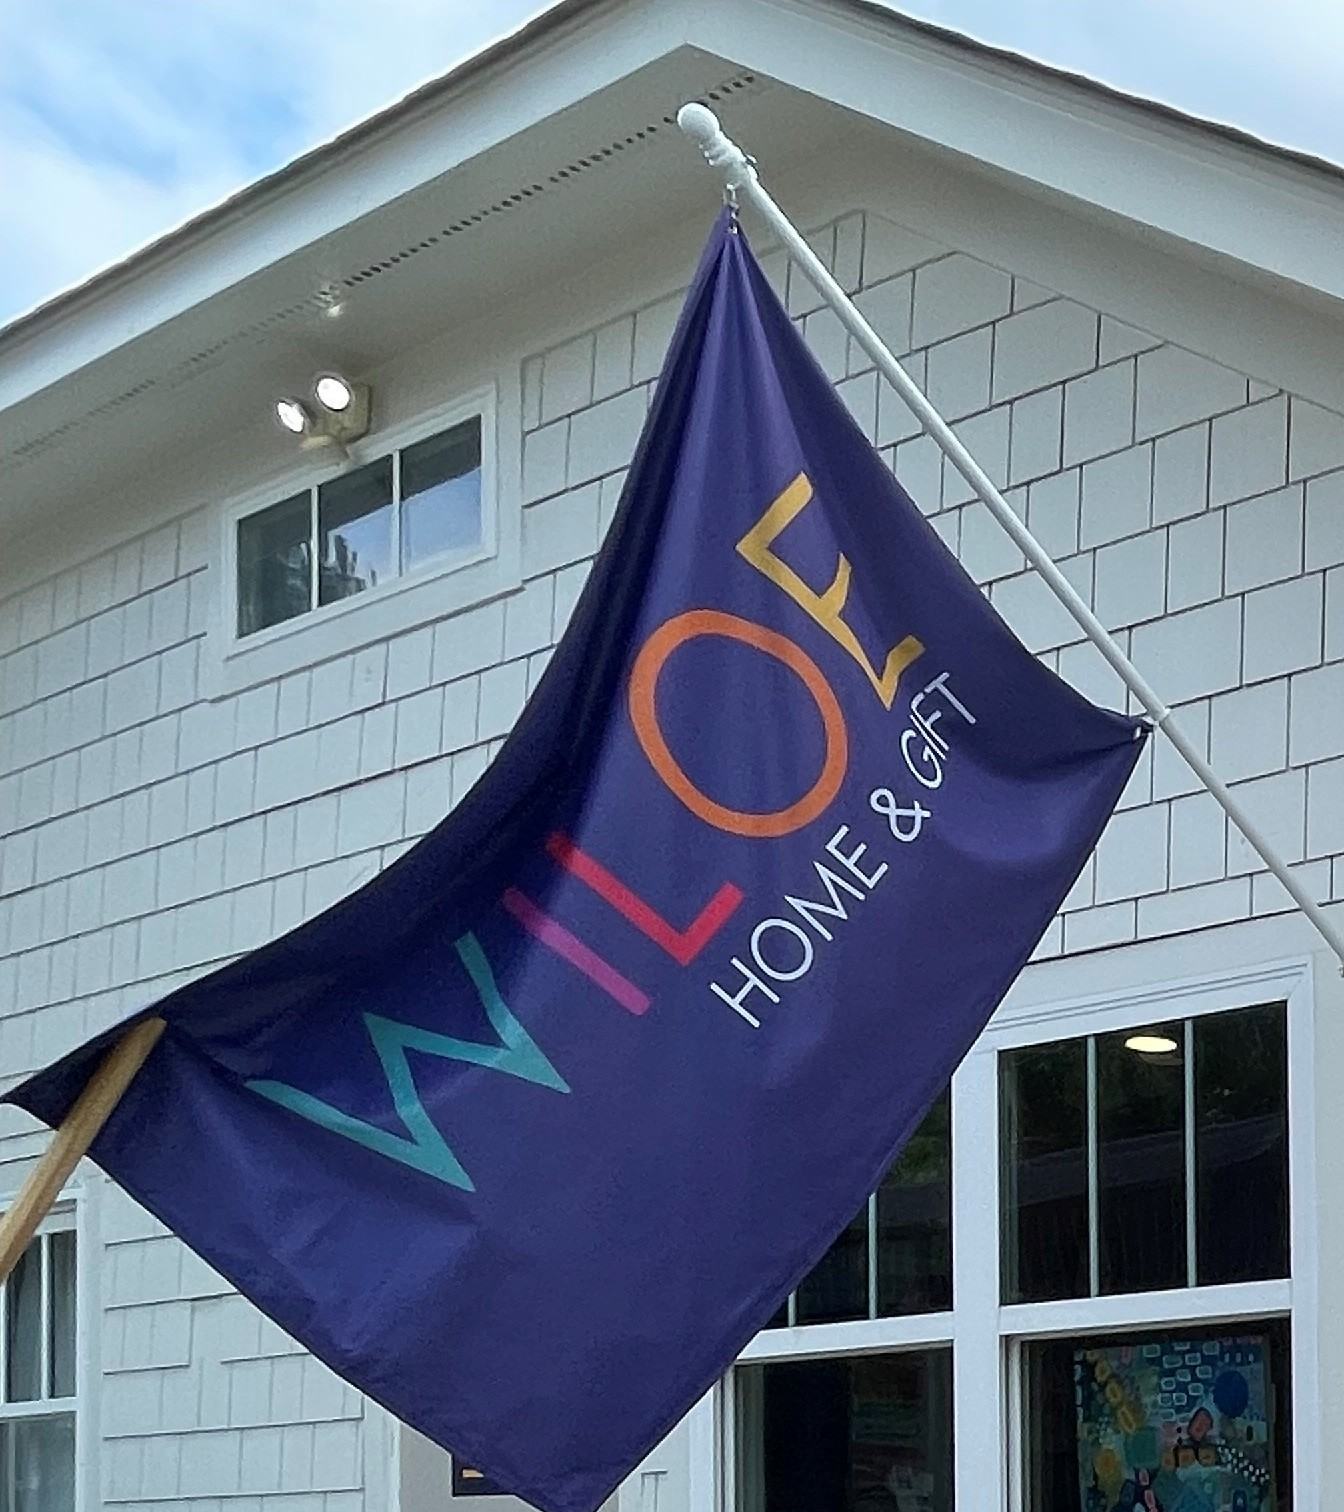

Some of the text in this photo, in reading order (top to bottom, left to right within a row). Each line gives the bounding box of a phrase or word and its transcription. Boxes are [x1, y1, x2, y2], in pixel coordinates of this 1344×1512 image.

[243, 472, 927, 1193] WILOE
[710, 672, 977, 1028] HOME & GIFT
